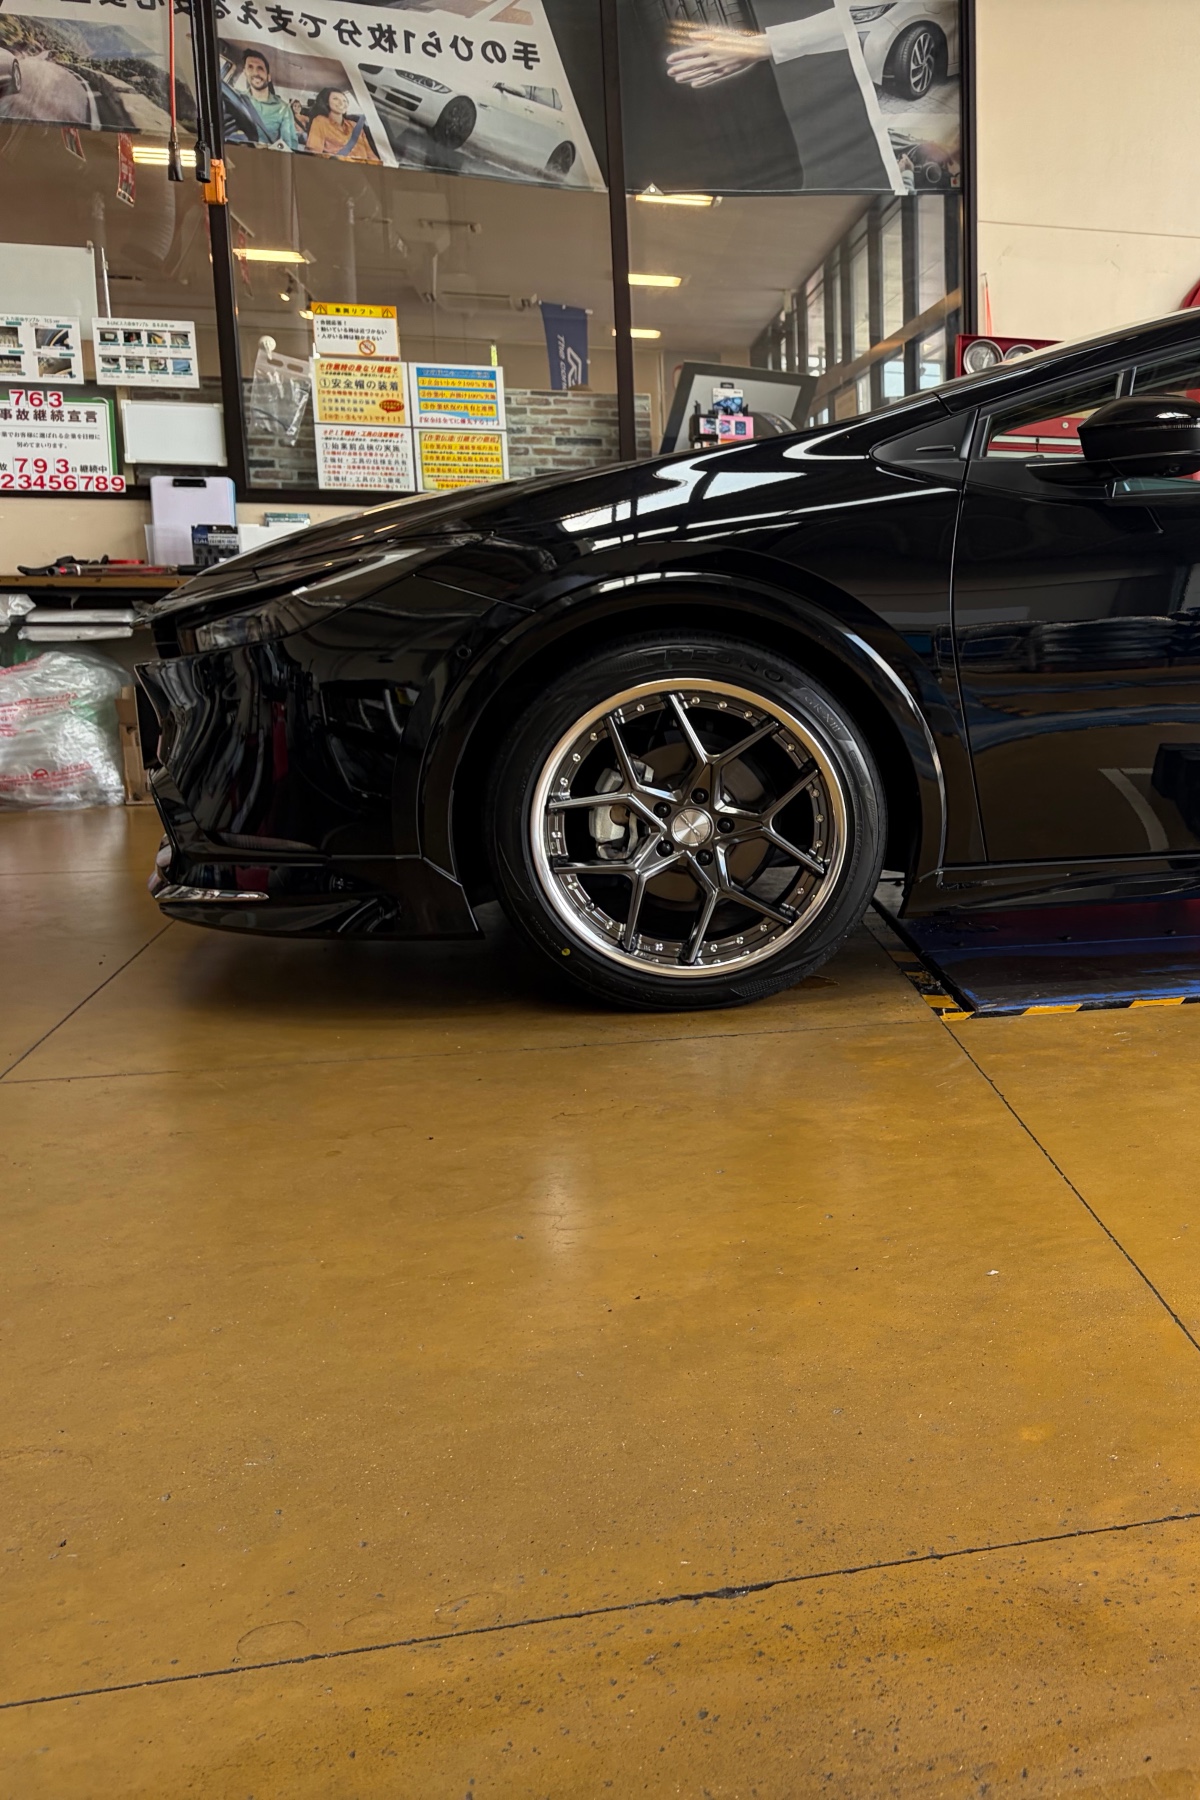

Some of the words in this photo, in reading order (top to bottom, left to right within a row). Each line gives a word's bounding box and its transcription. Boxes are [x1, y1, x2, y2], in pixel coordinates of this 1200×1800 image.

[10, 391, 63, 408] 763
[0, 408, 98, 424] 事故継続宣言
